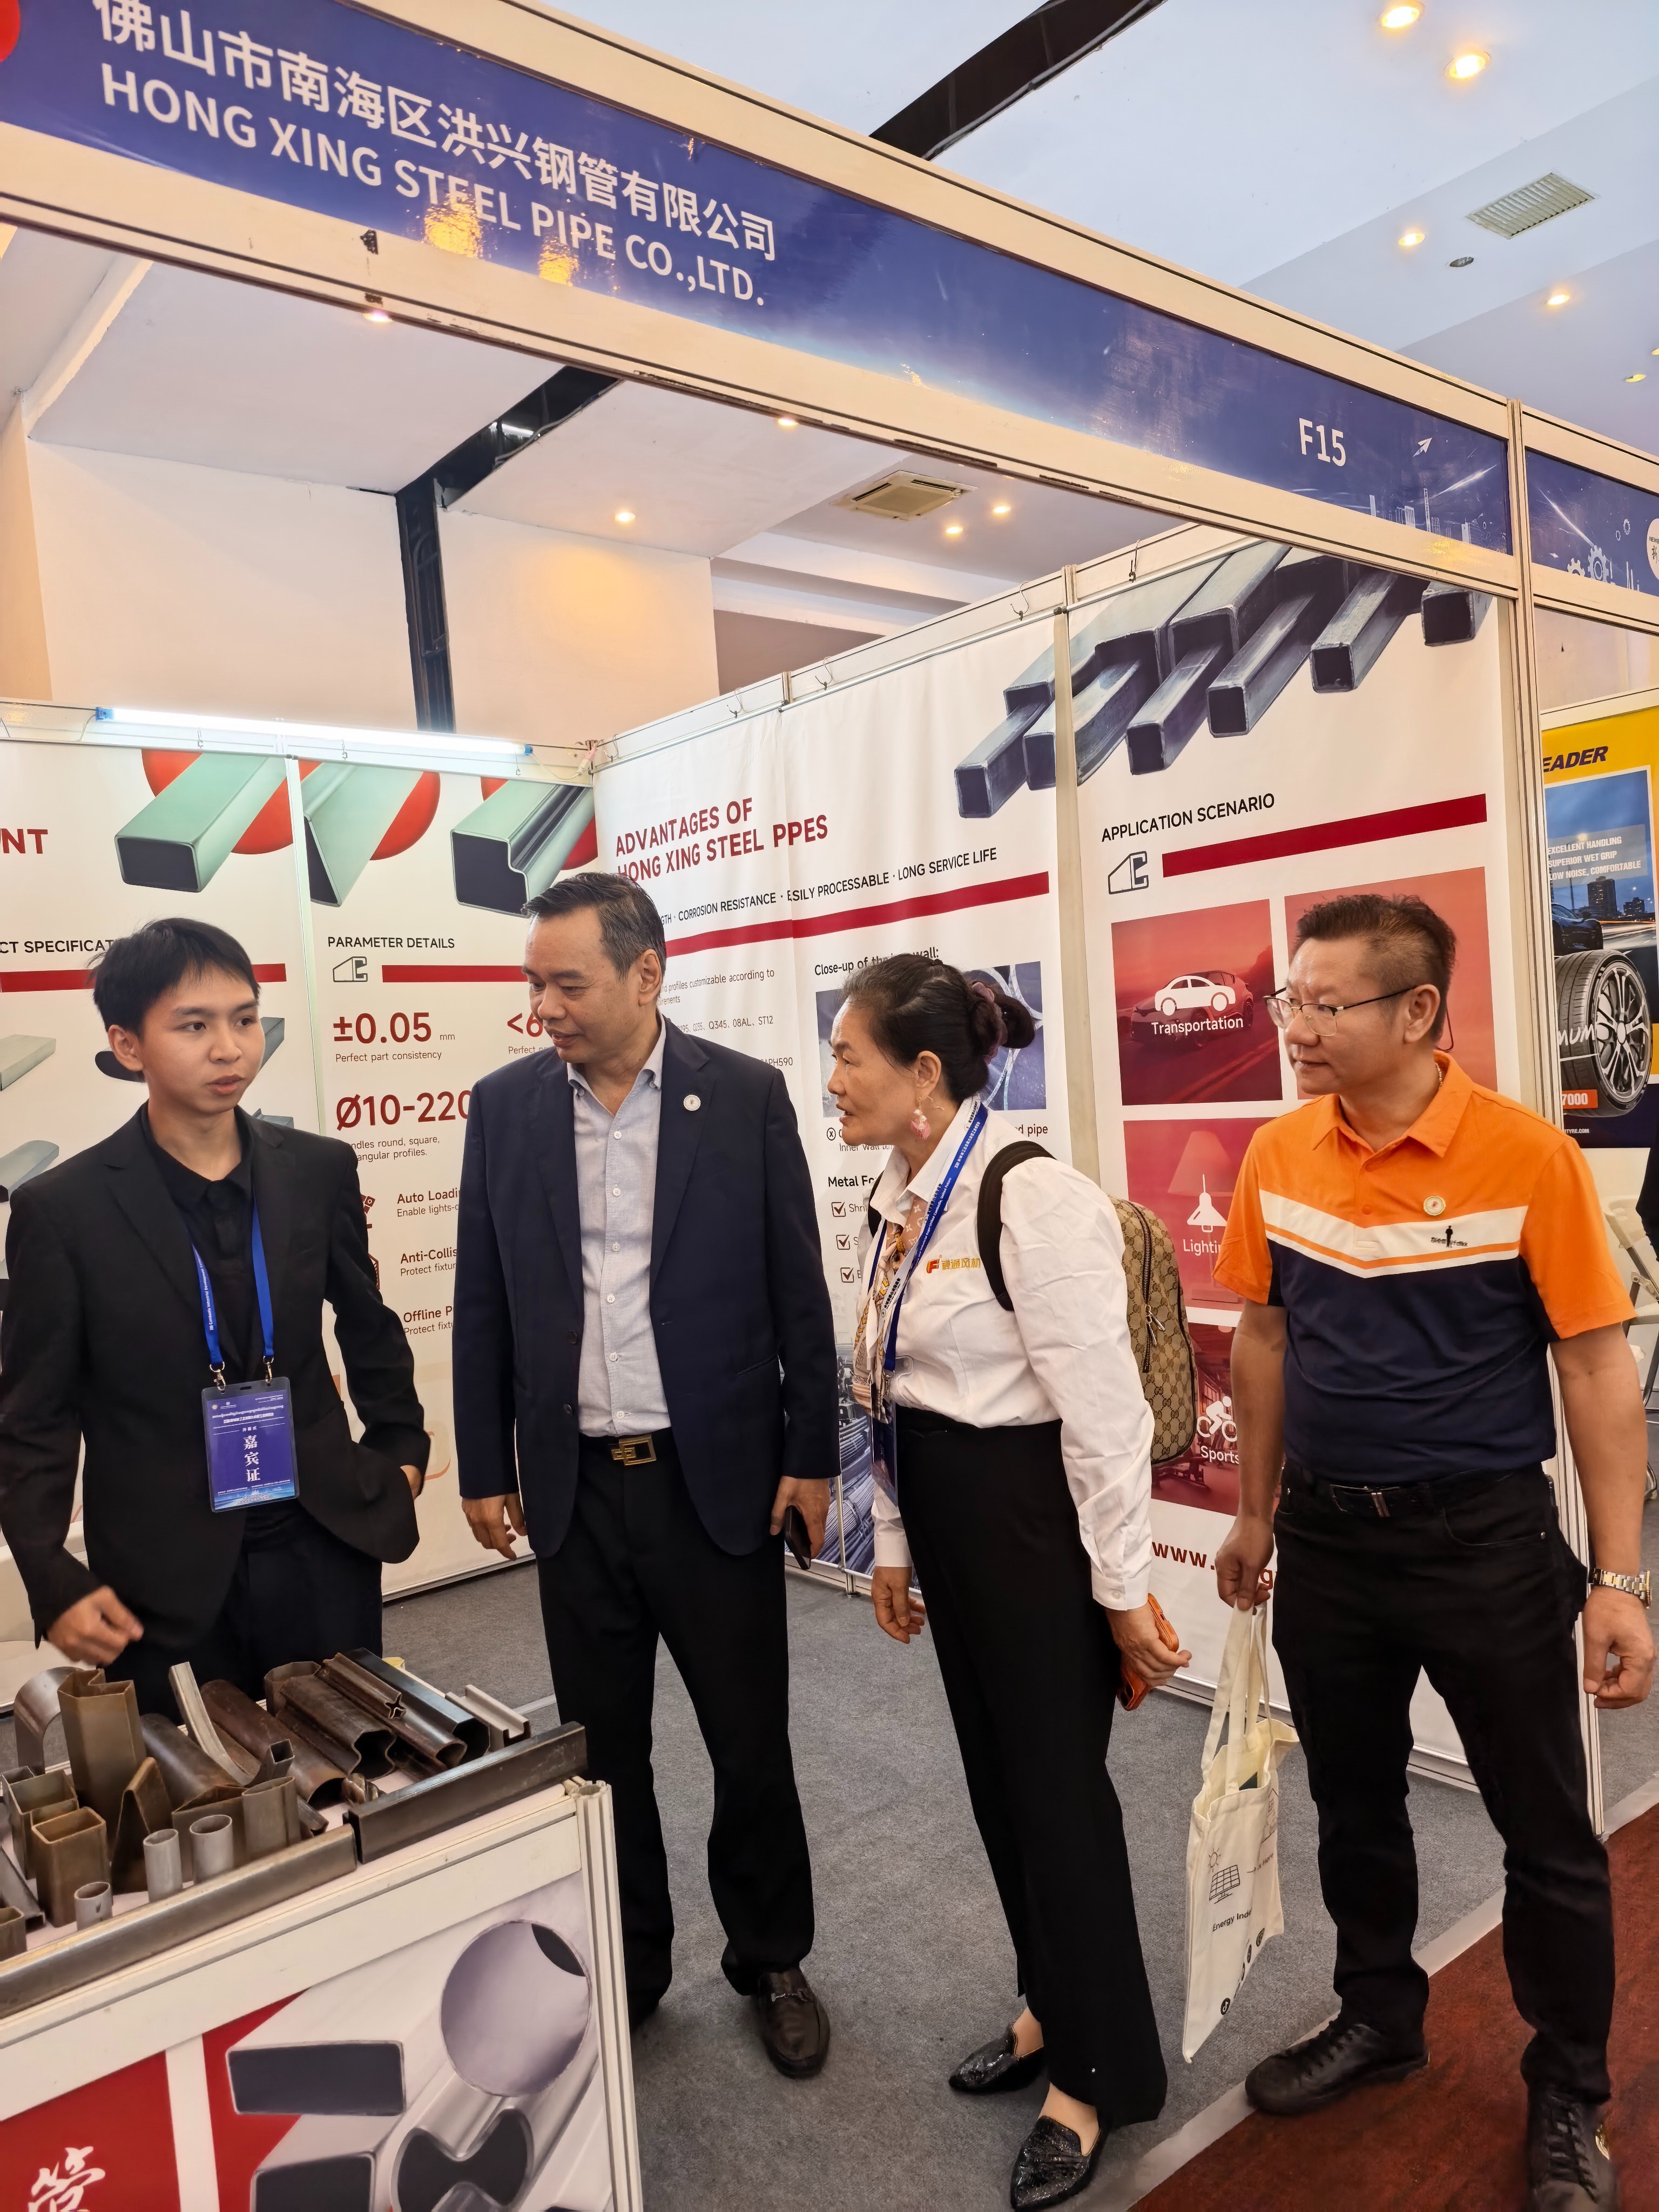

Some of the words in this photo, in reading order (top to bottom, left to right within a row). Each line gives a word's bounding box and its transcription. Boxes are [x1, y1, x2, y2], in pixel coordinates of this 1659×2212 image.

[93, 0, 776, 261] 佛山市南海区洪兴钢管有限公司
[102, 64, 257, 148] HONG
[269, 118, 382, 186] XING
[395, 159, 521, 231] STEEL
[532, 201, 616, 260] PIPE
[626, 234, 765, 306] CO.,LTD.
[1299, 417, 1346, 467] F15
[1102, 811, 1192, 842] APPLICATION
[1197, 793, 1274, 824] SCENARIO
[616, 806, 719, 857] ADVANTAGES
[727, 798, 752, 824] OF
[1548, 842, 1584, 855] EXCELLENT
[1587, 837, 1621, 848] HANDLING
[618, 856, 661, 882] HONG
[666, 844, 700, 873] XING
[707, 829, 764, 861] STEEL
[1549, 856, 1582, 867] SUPERIOR
[1584, 854, 1599, 862] WET
[1600, 851, 1617, 860] GRIP
[1549, 871, 1563, 881] LOW
[1566, 868, 1589, 878] NOISE,
[1590, 860, 1641, 875] COMFORTABLE
[679, 903, 718, 921] CORROSION
[720, 893, 777, 912] RESISTANCE
[818, 872, 889, 896] PROCESSABLE
[899, 864, 925, 881] LONG
[929, 853, 969, 874] SERVICE
[973, 848, 996, 864] LIFE
[328, 936, 403, 948] PARAMETER
[407, 938, 455, 948] DETAILS
[815, 962, 854, 975] Close-up
[858, 957, 868, 969] of
[669, 981, 688, 993] profiles
[690, 974, 726, 988] customizable
[729, 970, 764, 982] according
[767, 969, 774, 977] to
[333, 1012, 431, 1043] ±0.05
[758, 1015, 773, 1025] ST12
[1151, 1016, 1244, 1035] Transportation
[336, 1053, 367, 1062] Perfect
[371, 1052, 389, 1063] part
[392, 1051, 442, 1061] consistency
[761, 1057, 793, 1066] APH590
[1562, 1093, 1588, 1105] 7000
[1028, 1124, 1048, 1137] pipe
[378, 1137, 405, 1147] round,
[409, 1137, 440, 1147] square,
[394, 1149, 427, 1160] profiles.
[828, 1176, 859, 1187] Metal
[397, 1193, 424, 1204] Auto
[429, 1188, 460, 1201] Loadi
[397, 1207, 426, 1217] Enable
[849, 1204, 867, 1212] Shri
[1183, 1239, 1220, 1256] Lighti
[401, 1265, 431, 1276] Protect
[404, 1309, 441, 1323] Offline
[404, 1324, 435, 1334] Protect
[244, 1435, 261, 1482] 嘉宾证
[1201, 1445, 1239, 1464] Sports
[1213, 1917, 1235, 1932] Energy
